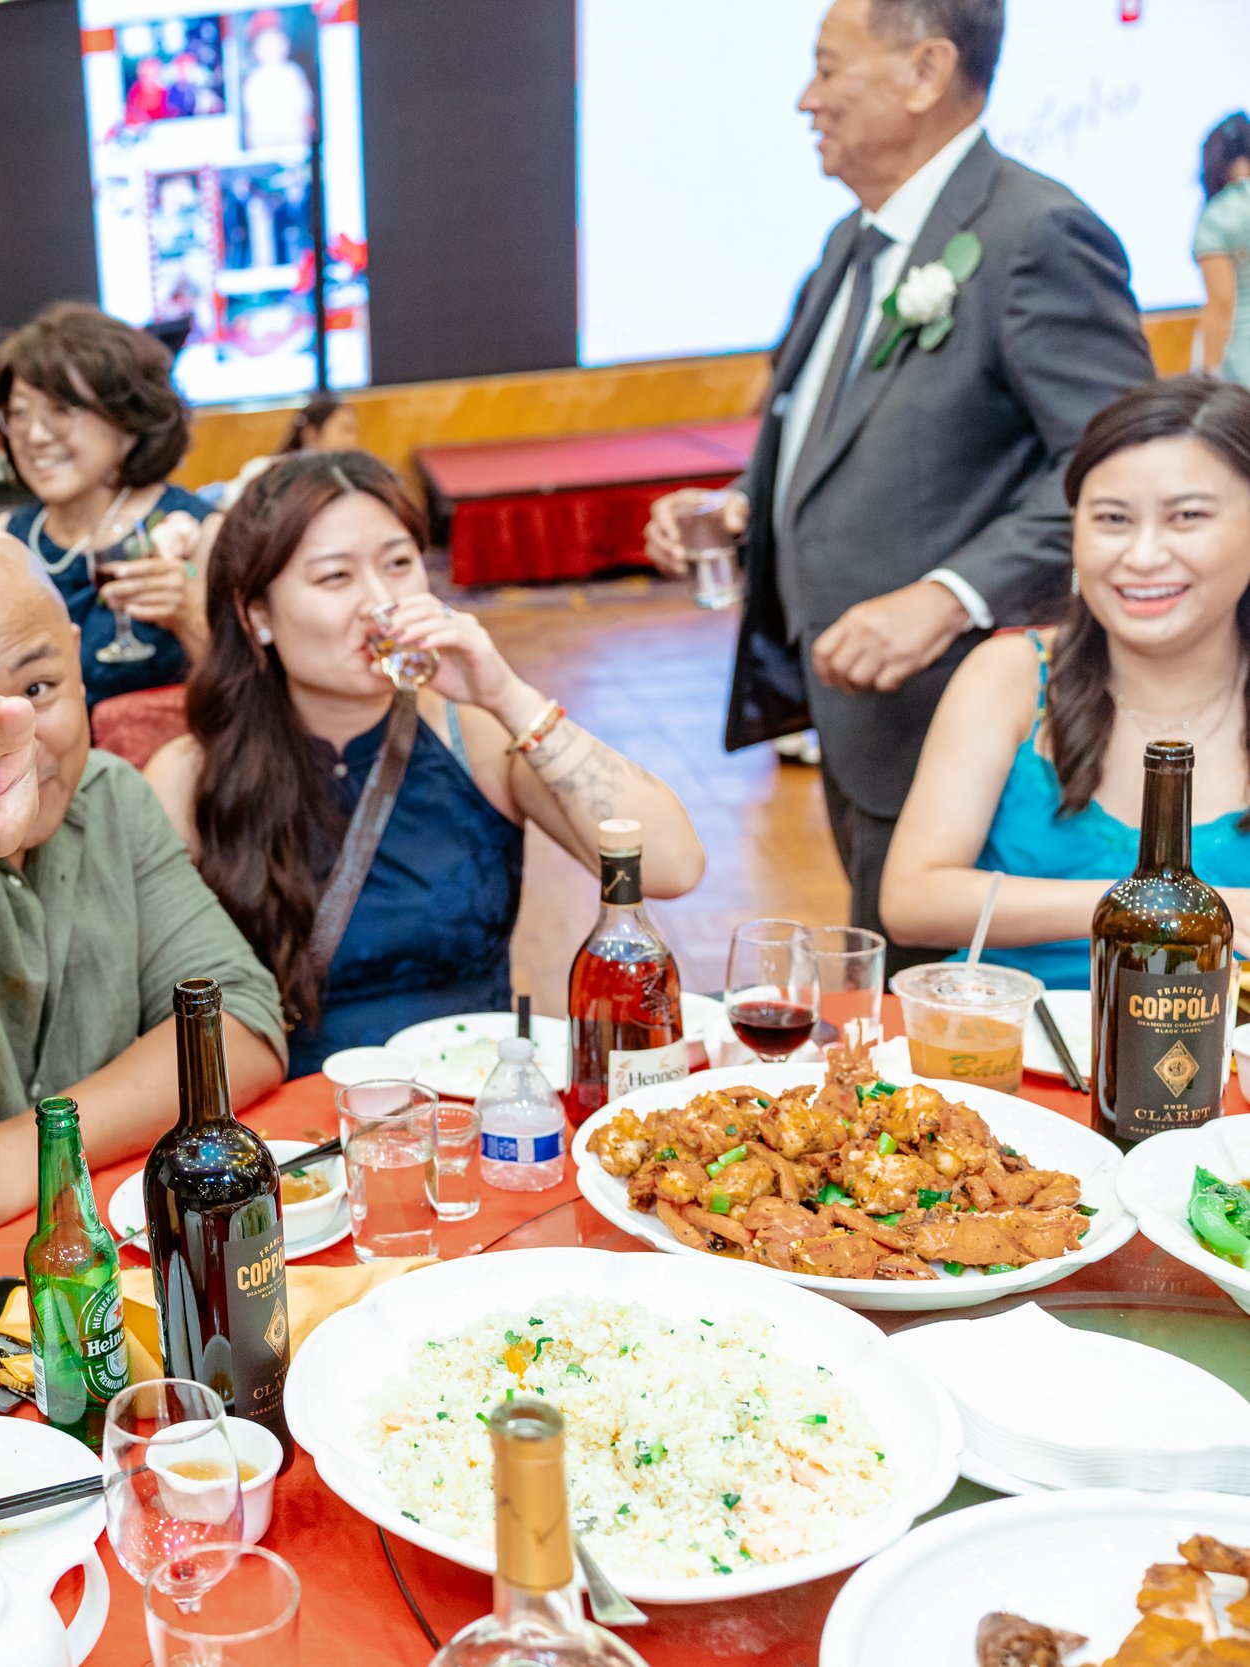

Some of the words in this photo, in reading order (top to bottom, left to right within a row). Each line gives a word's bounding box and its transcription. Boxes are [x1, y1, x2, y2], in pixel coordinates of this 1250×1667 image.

[1156, 986, 1203, 996] FRANCIS
[1129, 993, 1220, 1021] COPPOLA
[1137, 1020, 1172, 1028] DIAMOND
[1174, 1019, 1215, 1028] COLLECTION
[1134, 1106, 1211, 1122] CLARET
[97, 1370, 123, 1389] PREMIUM
